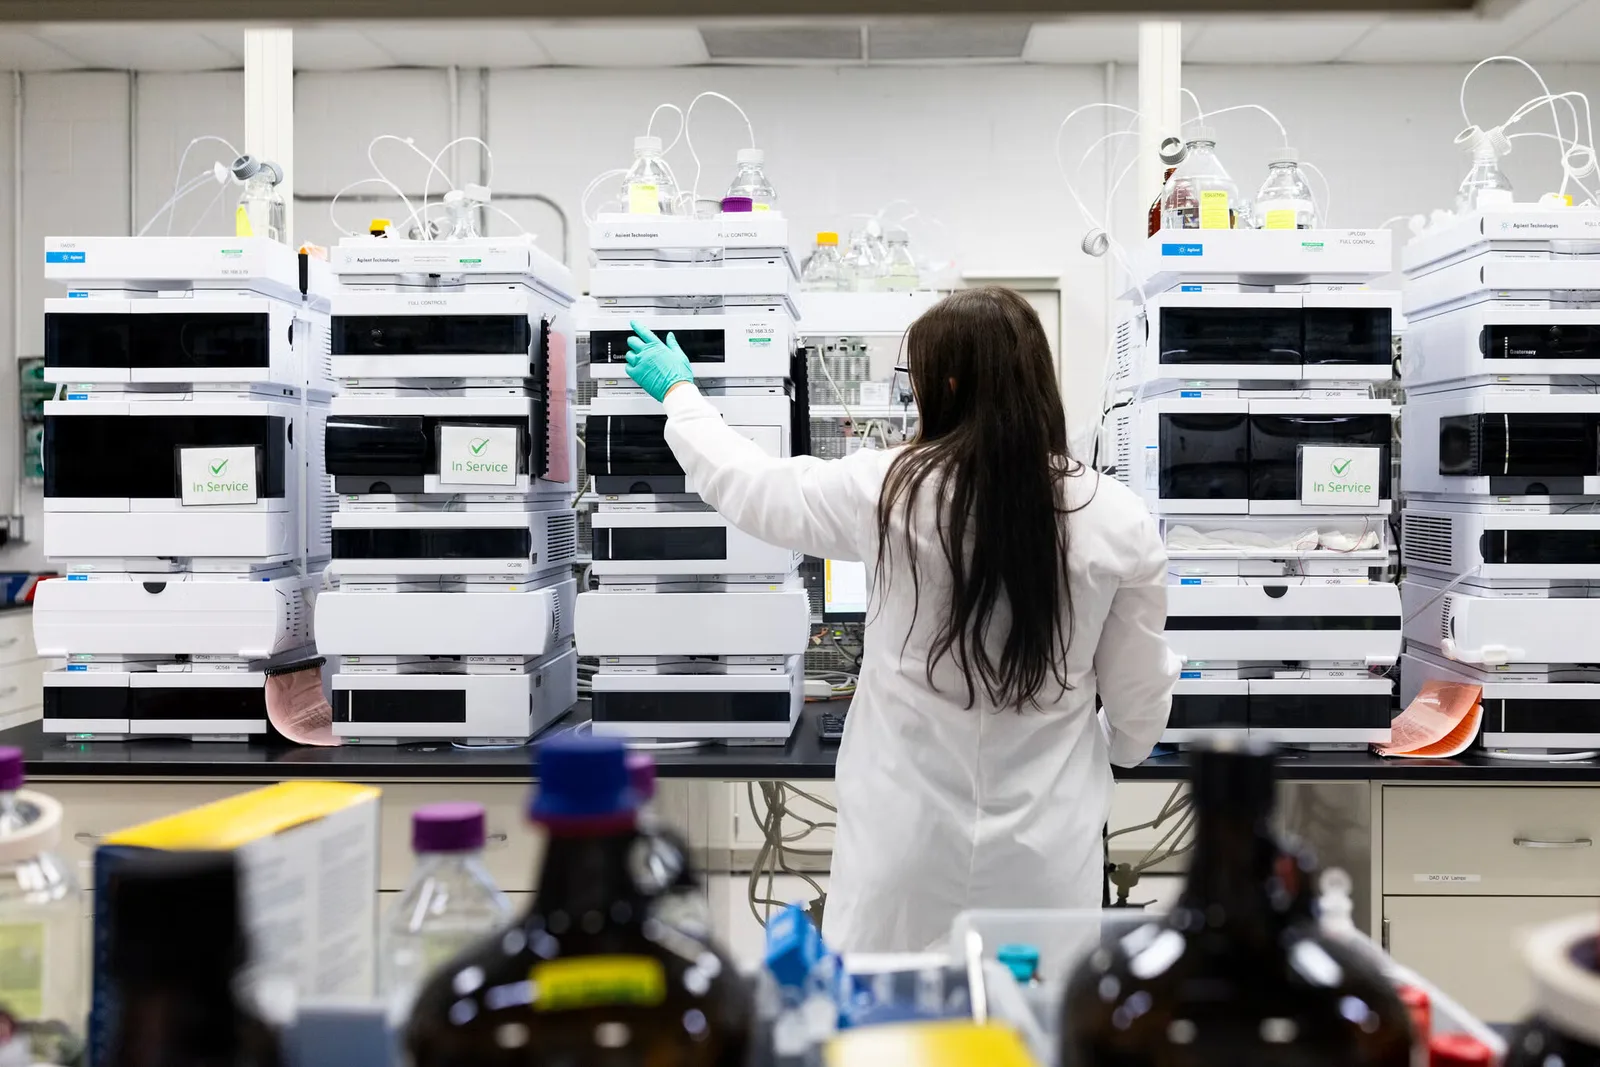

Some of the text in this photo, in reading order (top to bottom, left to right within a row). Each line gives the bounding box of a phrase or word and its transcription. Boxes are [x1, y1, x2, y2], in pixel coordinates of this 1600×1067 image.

[452, 461, 508, 472] In Service
[193, 481, 249, 492] In Service
[1313, 482, 1371, 493] In Service
